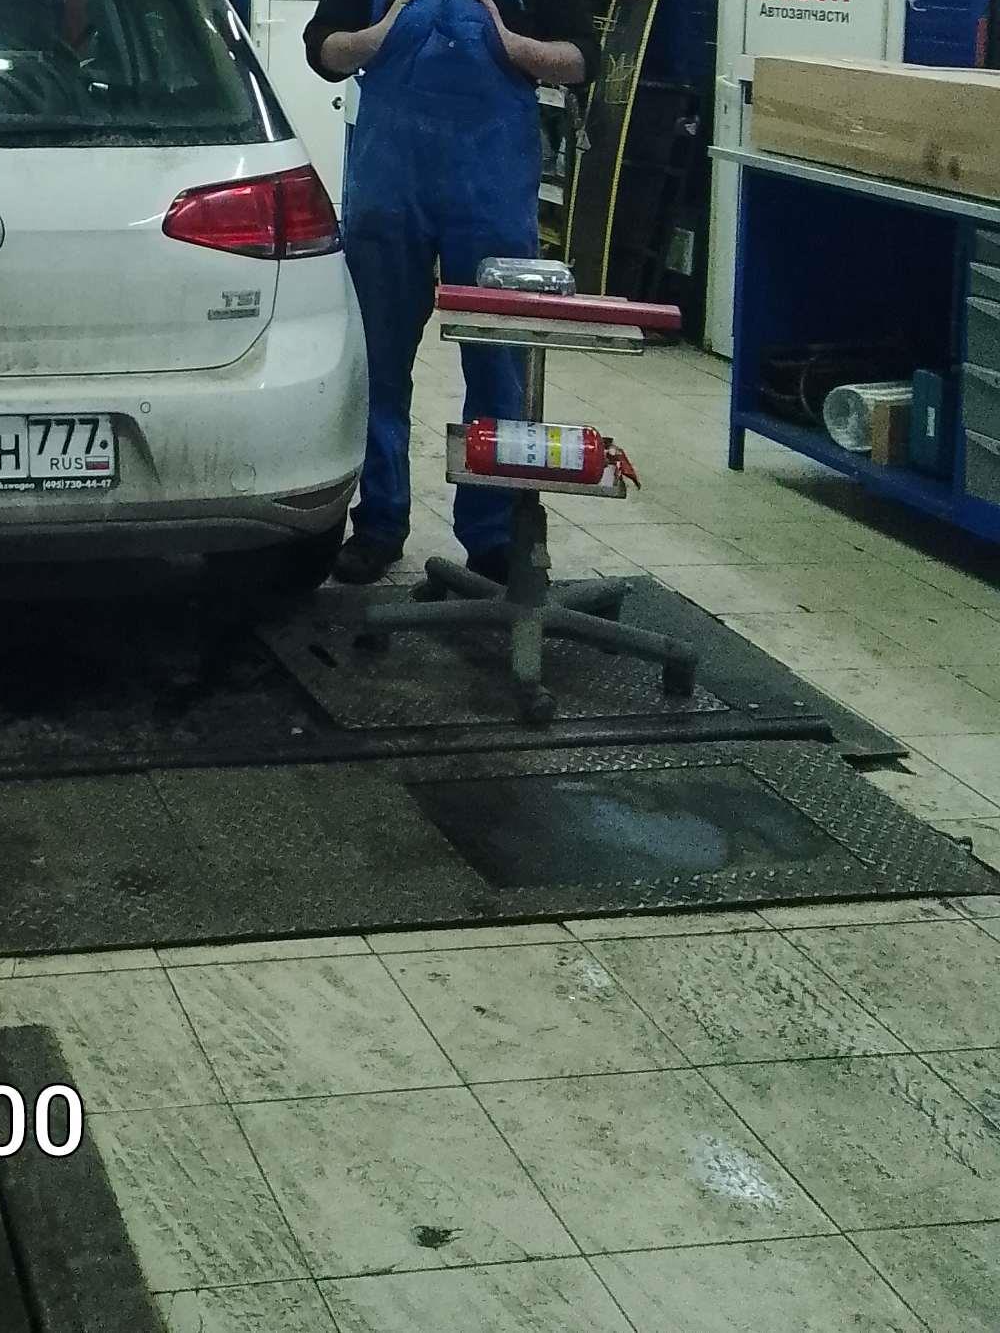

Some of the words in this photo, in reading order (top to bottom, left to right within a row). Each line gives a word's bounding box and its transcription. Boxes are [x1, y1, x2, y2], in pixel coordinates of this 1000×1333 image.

[760, 2, 849, 23] Автозапчасти
[29, 418, 101, 455] 777
[50, 457, 84, 470] RUS
